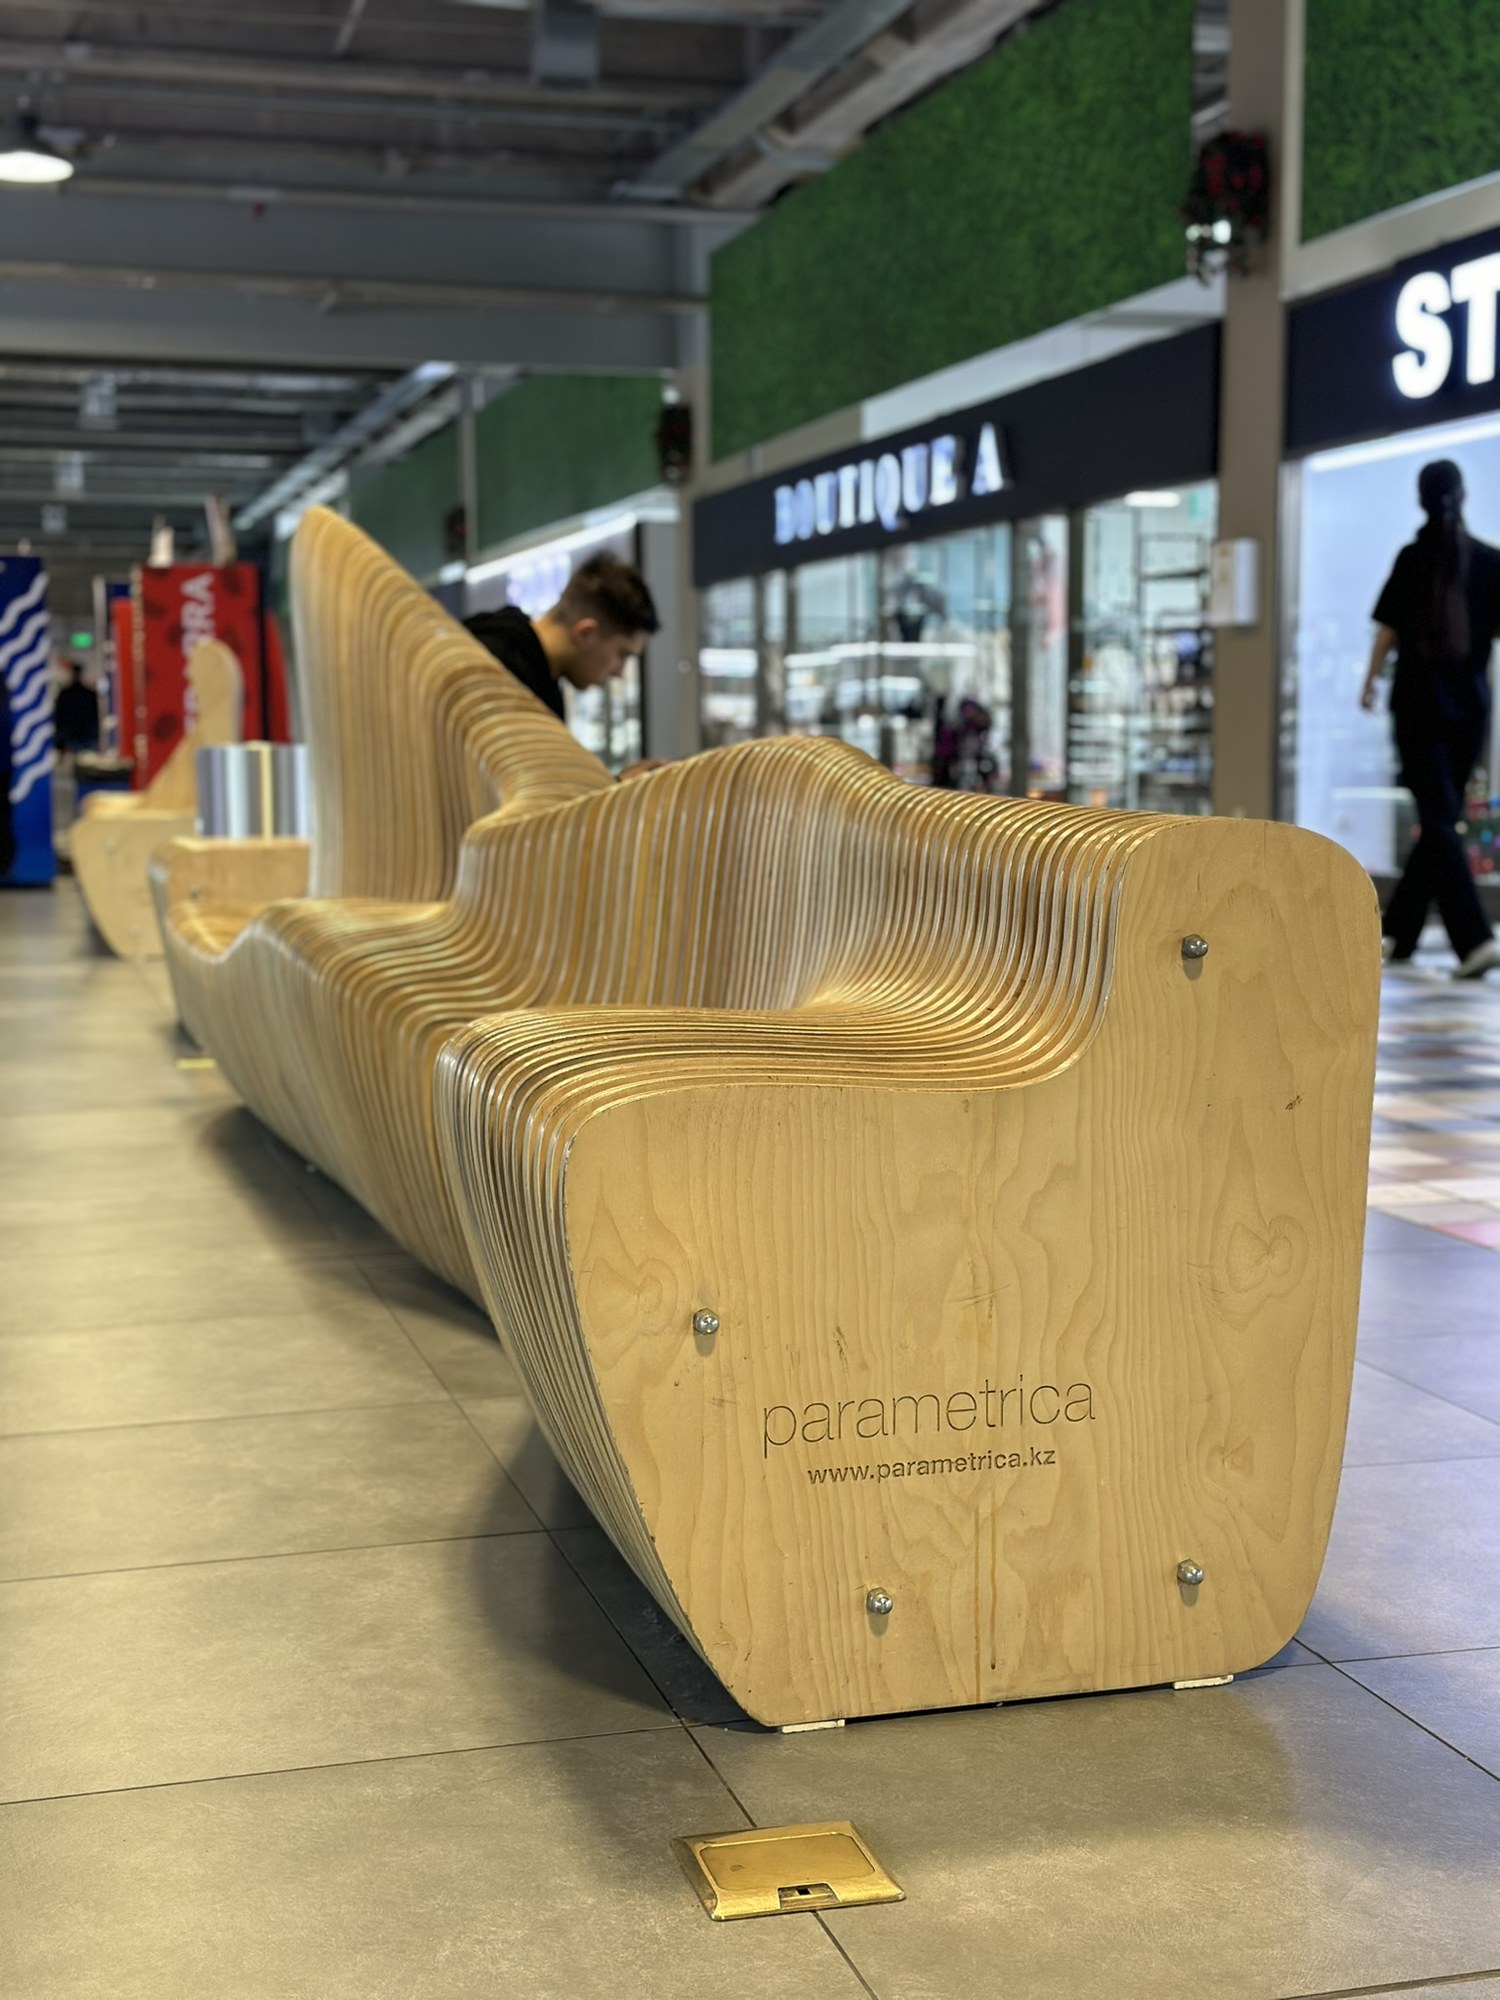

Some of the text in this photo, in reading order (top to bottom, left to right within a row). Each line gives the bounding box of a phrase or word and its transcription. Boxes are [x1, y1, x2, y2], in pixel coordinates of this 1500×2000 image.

[774, 421, 1003, 545] BOUTIQUE A
[763, 1373, 1096, 1460] parametrica
[807, 1446, 1056, 1485] www.parametrica.kz
